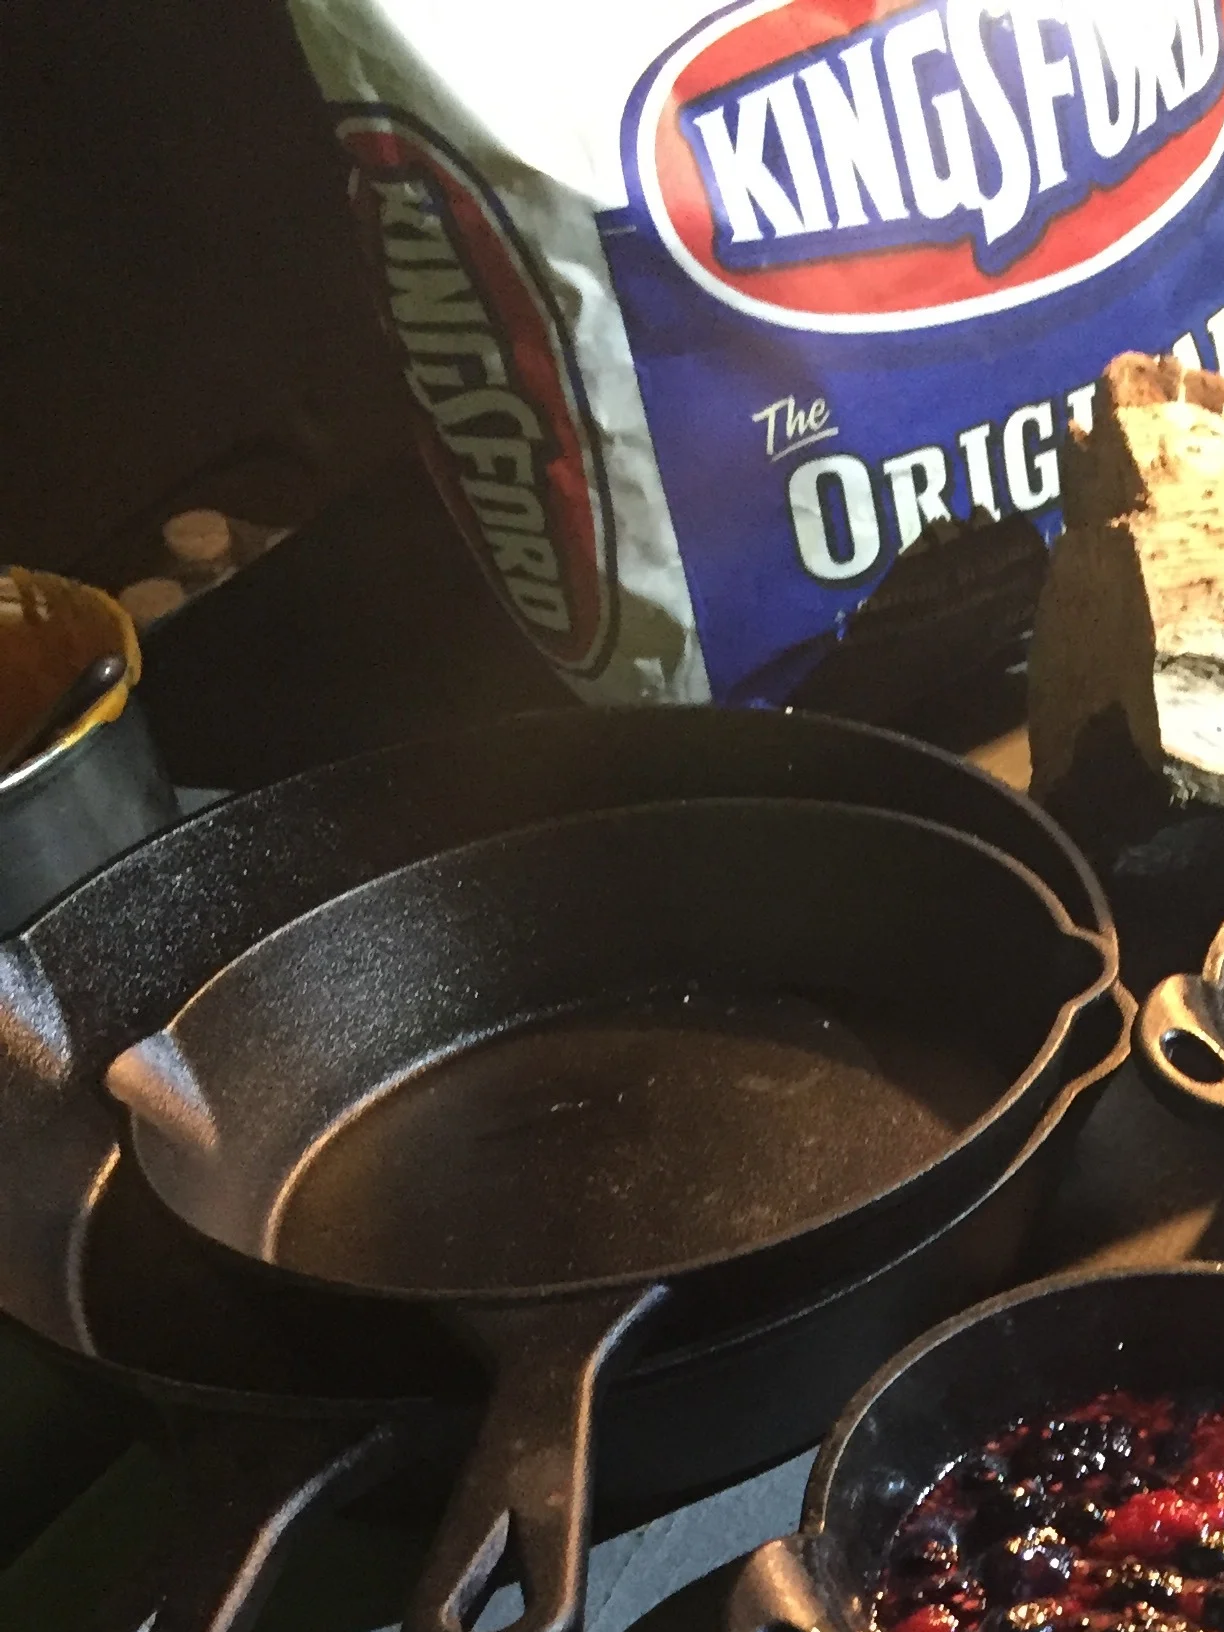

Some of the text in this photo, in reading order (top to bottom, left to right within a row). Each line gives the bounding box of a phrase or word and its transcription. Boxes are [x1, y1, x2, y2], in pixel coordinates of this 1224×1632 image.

[692, 0, 1219, 246] KINGSFORD
[372, 180, 572, 632] KINGSFORD
[752, 394, 838, 461] The
